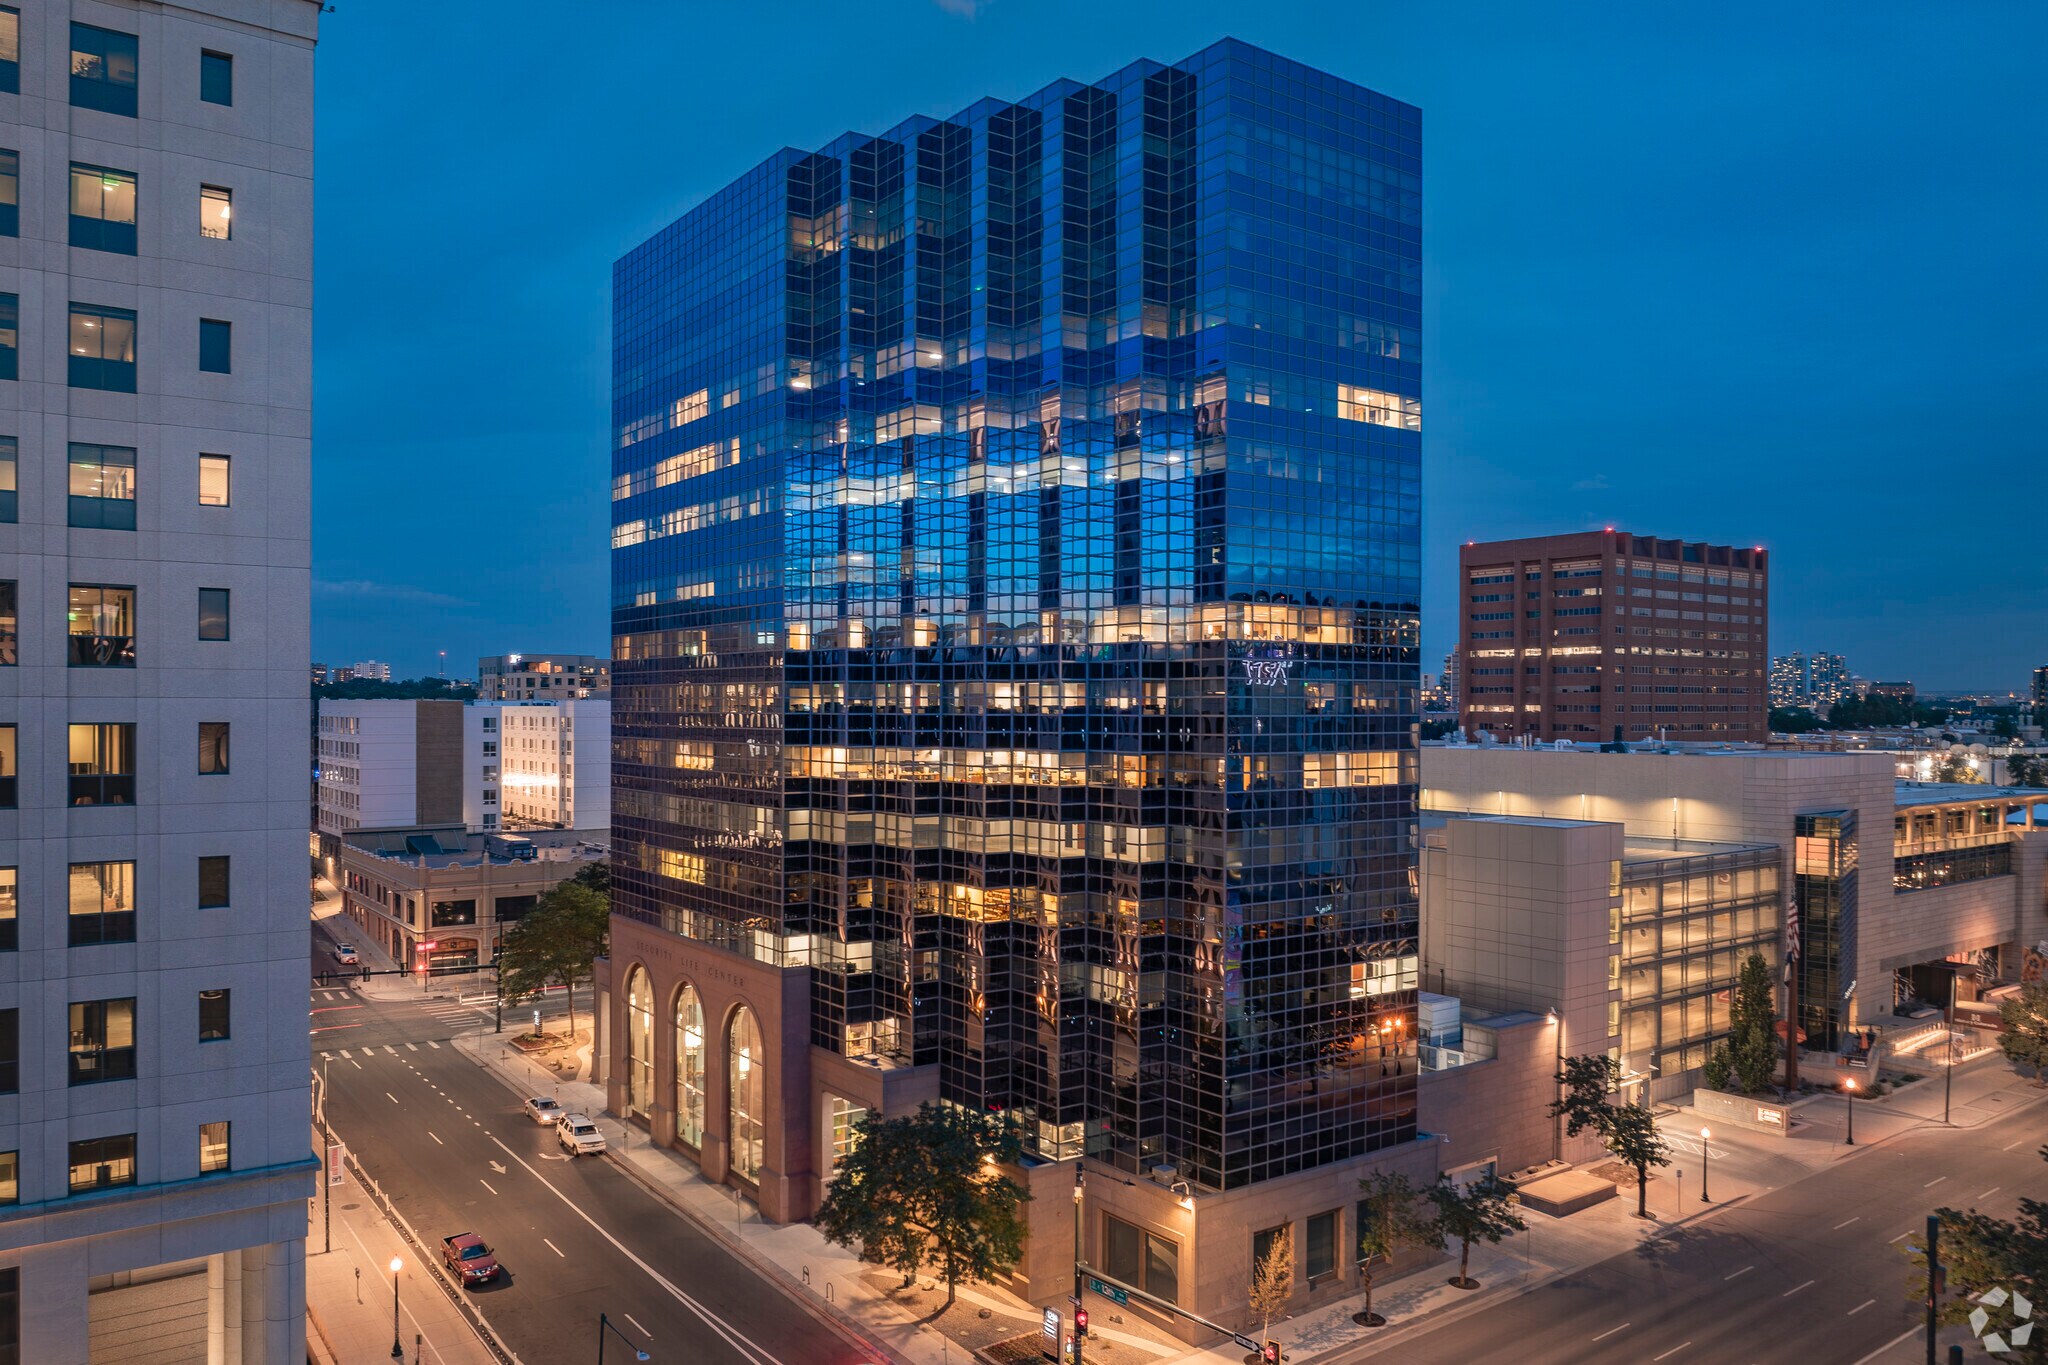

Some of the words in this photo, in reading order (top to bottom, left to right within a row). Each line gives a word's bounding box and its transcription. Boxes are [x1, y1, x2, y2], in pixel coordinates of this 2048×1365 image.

[636, 940, 673, 961] SECURITY
[681, 957, 699, 971] LIFE
[708, 967, 744, 986] CENTER
